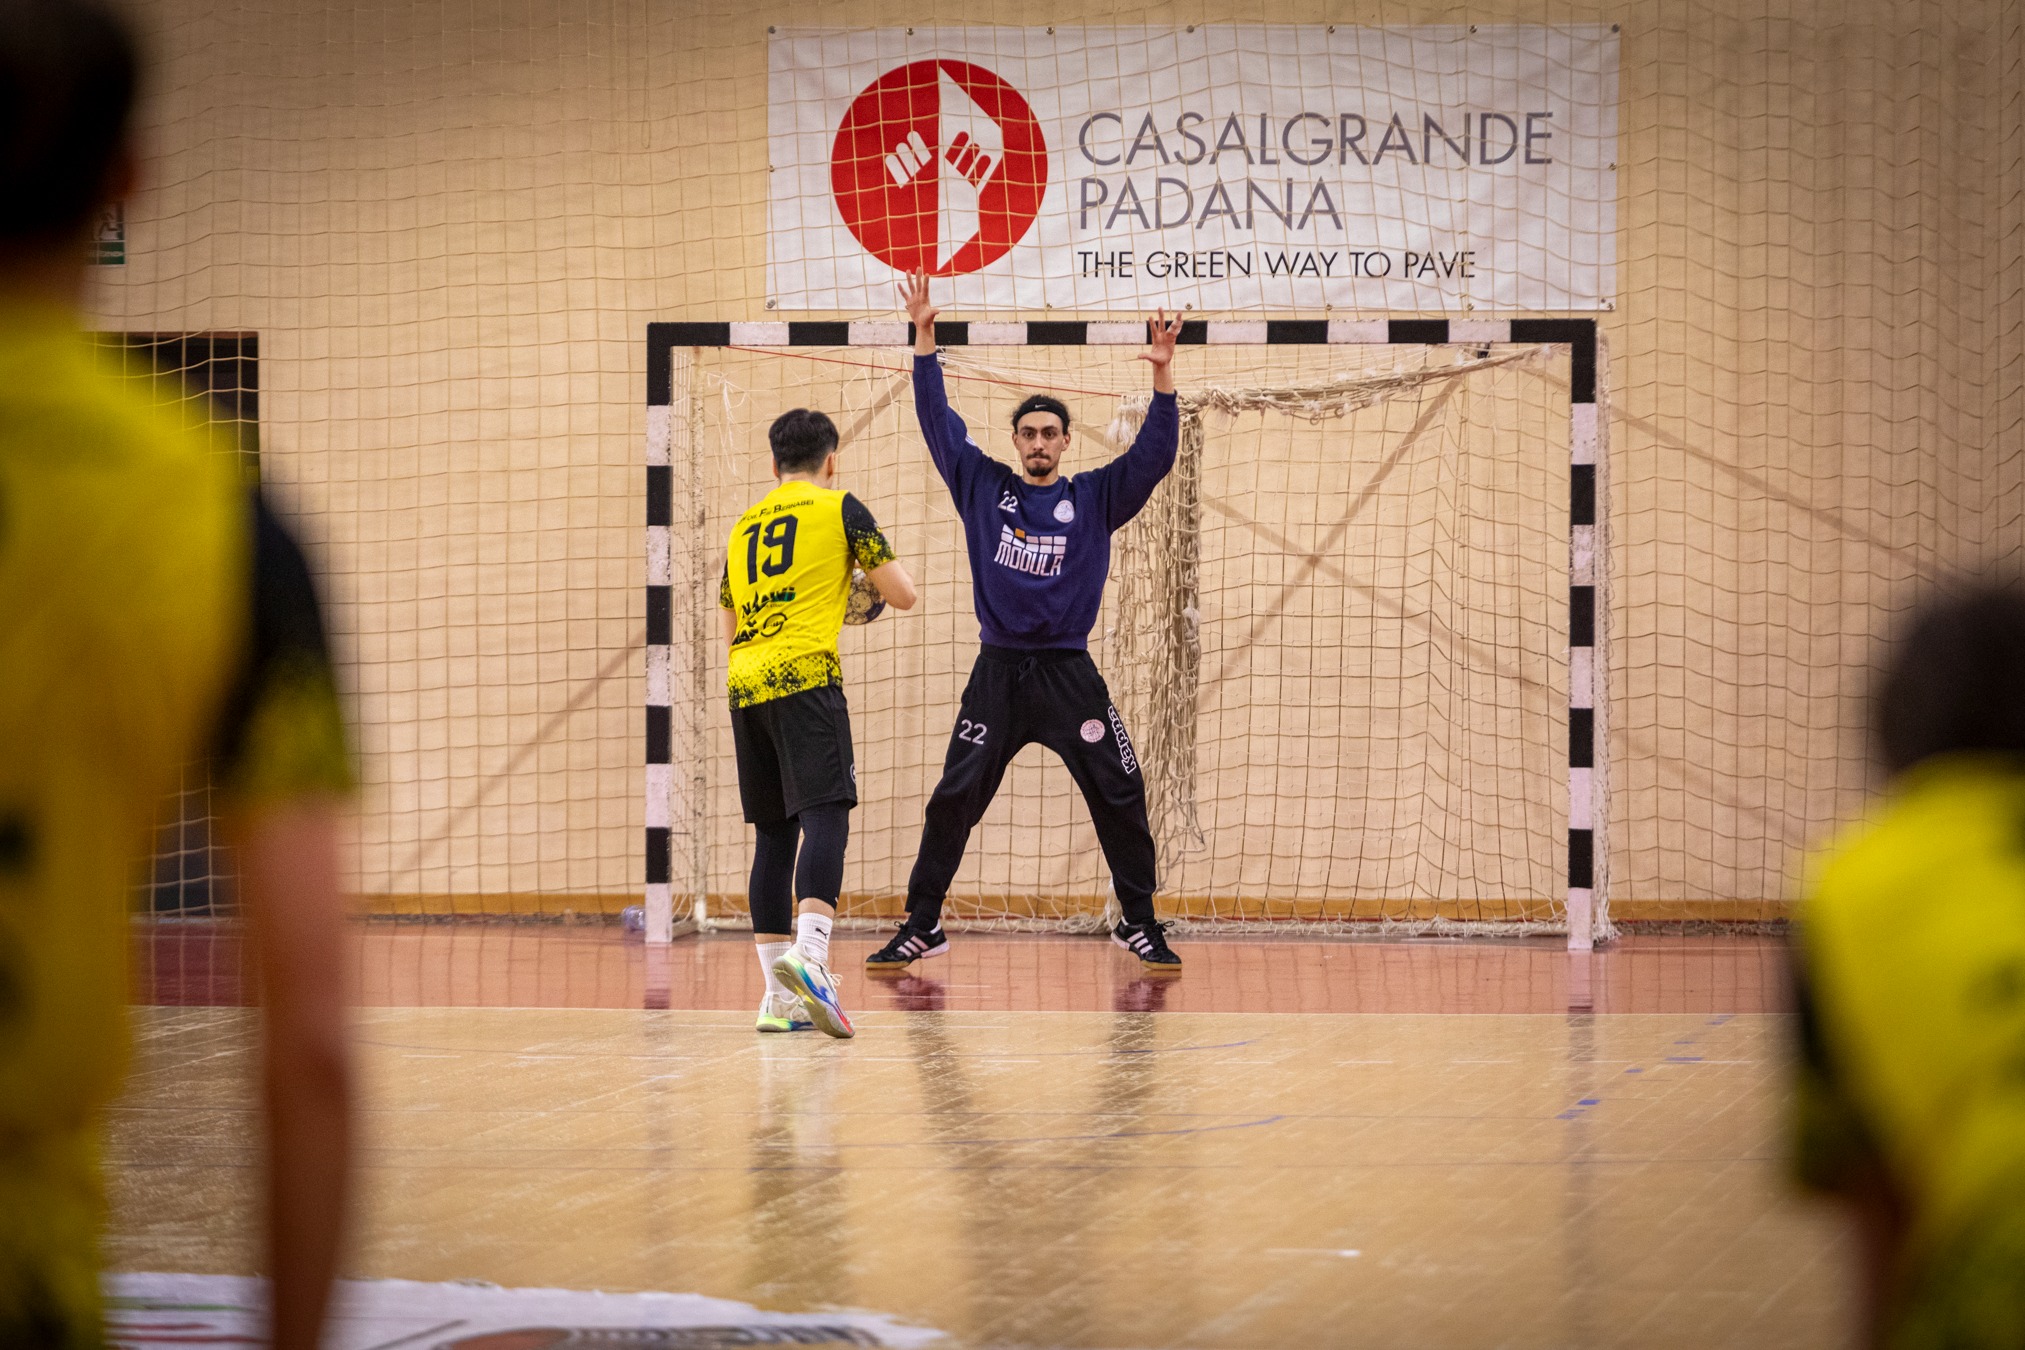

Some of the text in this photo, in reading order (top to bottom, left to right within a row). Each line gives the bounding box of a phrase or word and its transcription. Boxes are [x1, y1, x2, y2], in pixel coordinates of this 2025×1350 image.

[1078, 111, 1553, 166] CASALGRANDE
[1080, 176, 1343, 231] PADANA
[1077, 251, 1475, 278] THE GREEN WAY TO PAVE
[998, 490, 1018, 513] 22
[742, 514, 798, 585] 19
[994, 541, 1064, 577] MODULA
[958, 719, 987, 745] 22
